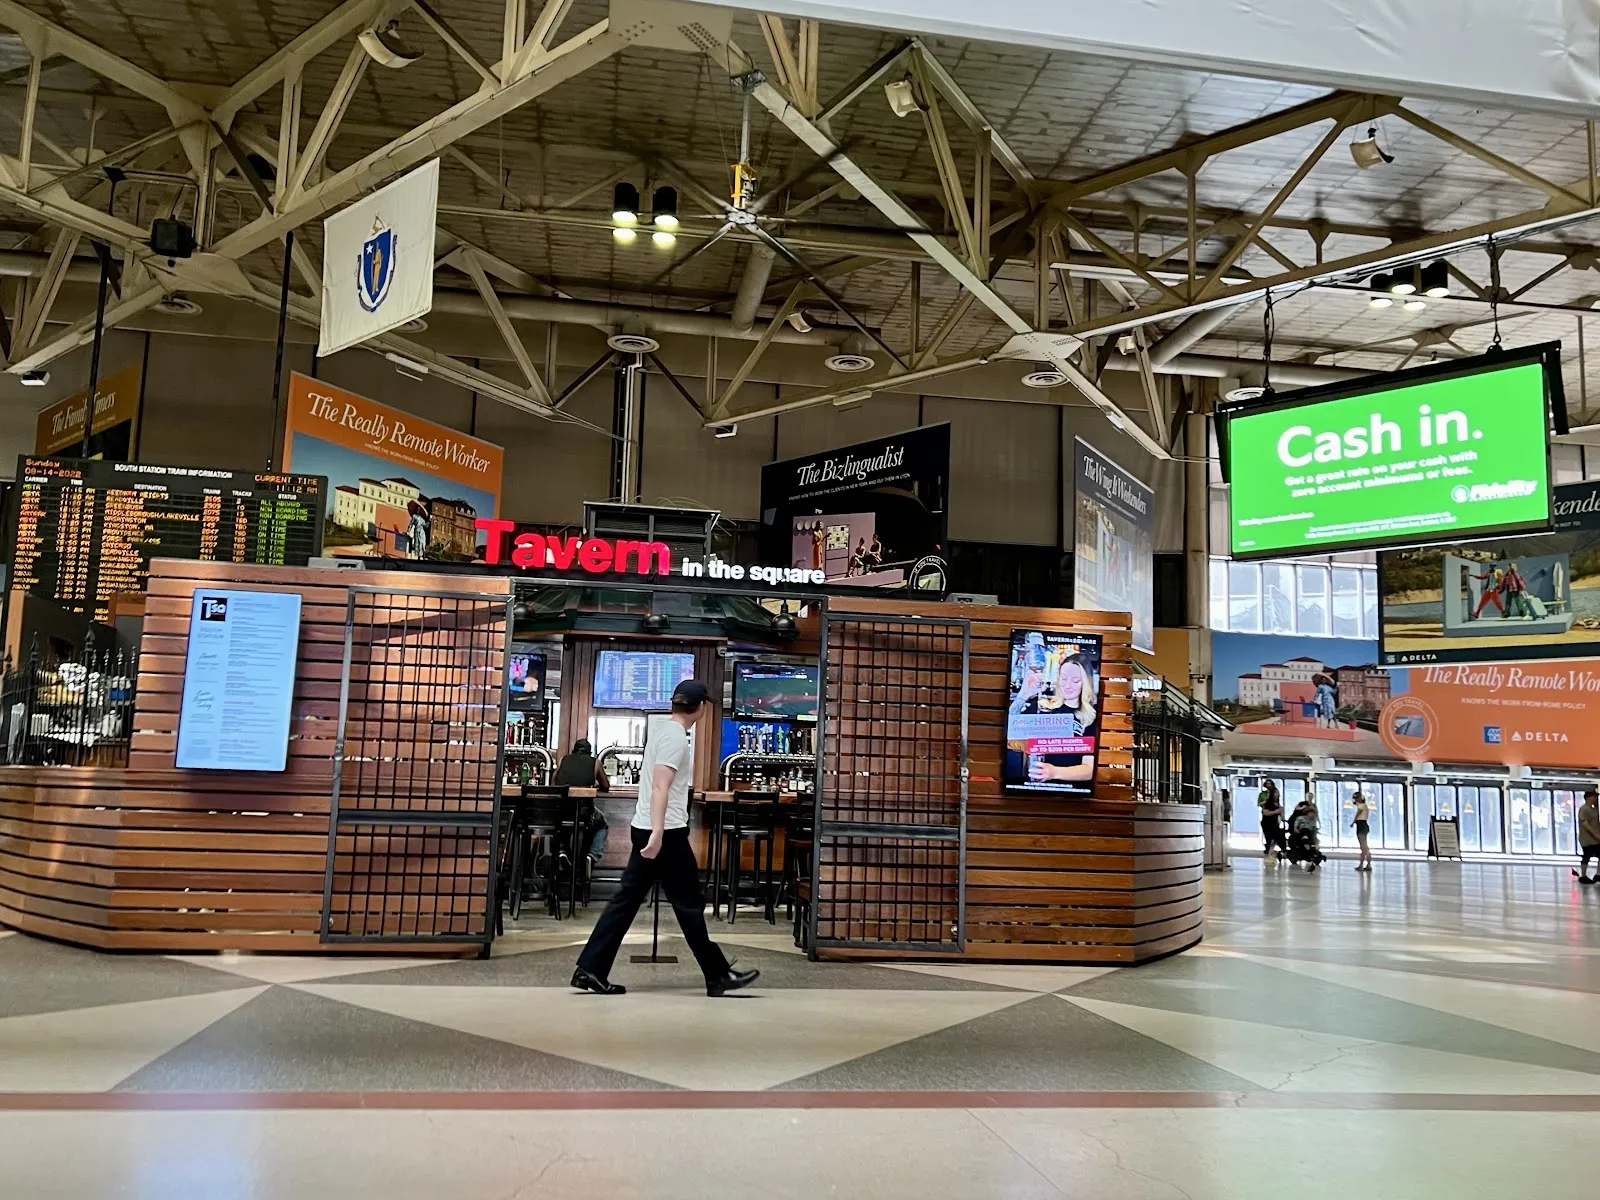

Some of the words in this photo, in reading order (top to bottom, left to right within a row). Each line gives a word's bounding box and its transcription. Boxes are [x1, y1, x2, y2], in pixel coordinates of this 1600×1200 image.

[52, 410, 65, 435] The
[308, 392, 338, 422] The
[339, 403, 389, 444] Really
[390, 421, 443, 458] Remote
[443, 439, 491, 473] Worker
[1277, 412, 1402, 468] Cash
[1419, 404, 1483, 448] in.
[26, 458, 60, 468] Sunday
[114, 463, 138, 472] SOUTH
[138, 465, 167, 474] STATION
[167, 467, 188, 476] TRAIN
[188, 469, 233, 479] INFORMATION
[797, 462, 821, 486] The
[820, 445, 905, 483] Bizlingualist
[1083, 455, 1096, 480] The
[1284, 476, 1305, 487] Get
[1307, 475, 1314, 483] a
[1315, 470, 1346, 485] great
[1347, 467, 1370, 478] rate
[1372, 465, 1388, 474] on
[1390, 460, 1417, 474] your
[1419, 454, 1448, 468] cash
[1448, 449, 1478, 464] with
[25, 476, 48, 484] CARRIER
[71, 478, 83, 486] TIME
[133, 483, 168, 491] DESTINATION
[254, 474, 292, 484] CURRENT
[297, 477, 318, 485] TIME
[276, 485, 302, 493] 11:12
[1291, 487, 1316, 498] zero
[1317, 480, 1362, 494] account
[1363, 471, 1424, 488] minimums
[1426, 470, 1440, 480] or
[1442, 465, 1474, 477] fees.
[475, 518, 671, 575] Tavern
[682, 557, 703, 577] in
[708, 559, 744, 580] the
[750, 564, 825, 586] square
[1421, 666, 1452, 684] The
[1454, 665, 1505, 693] Really
[1507, 668, 1566, 689] Remote
[1461, 697, 1486, 705] KNOWS
[1562, 701, 1587, 710] POLICY
[1034, 717, 1070, 725] HIRING
[1525, 731, 1569, 743] DELTA
